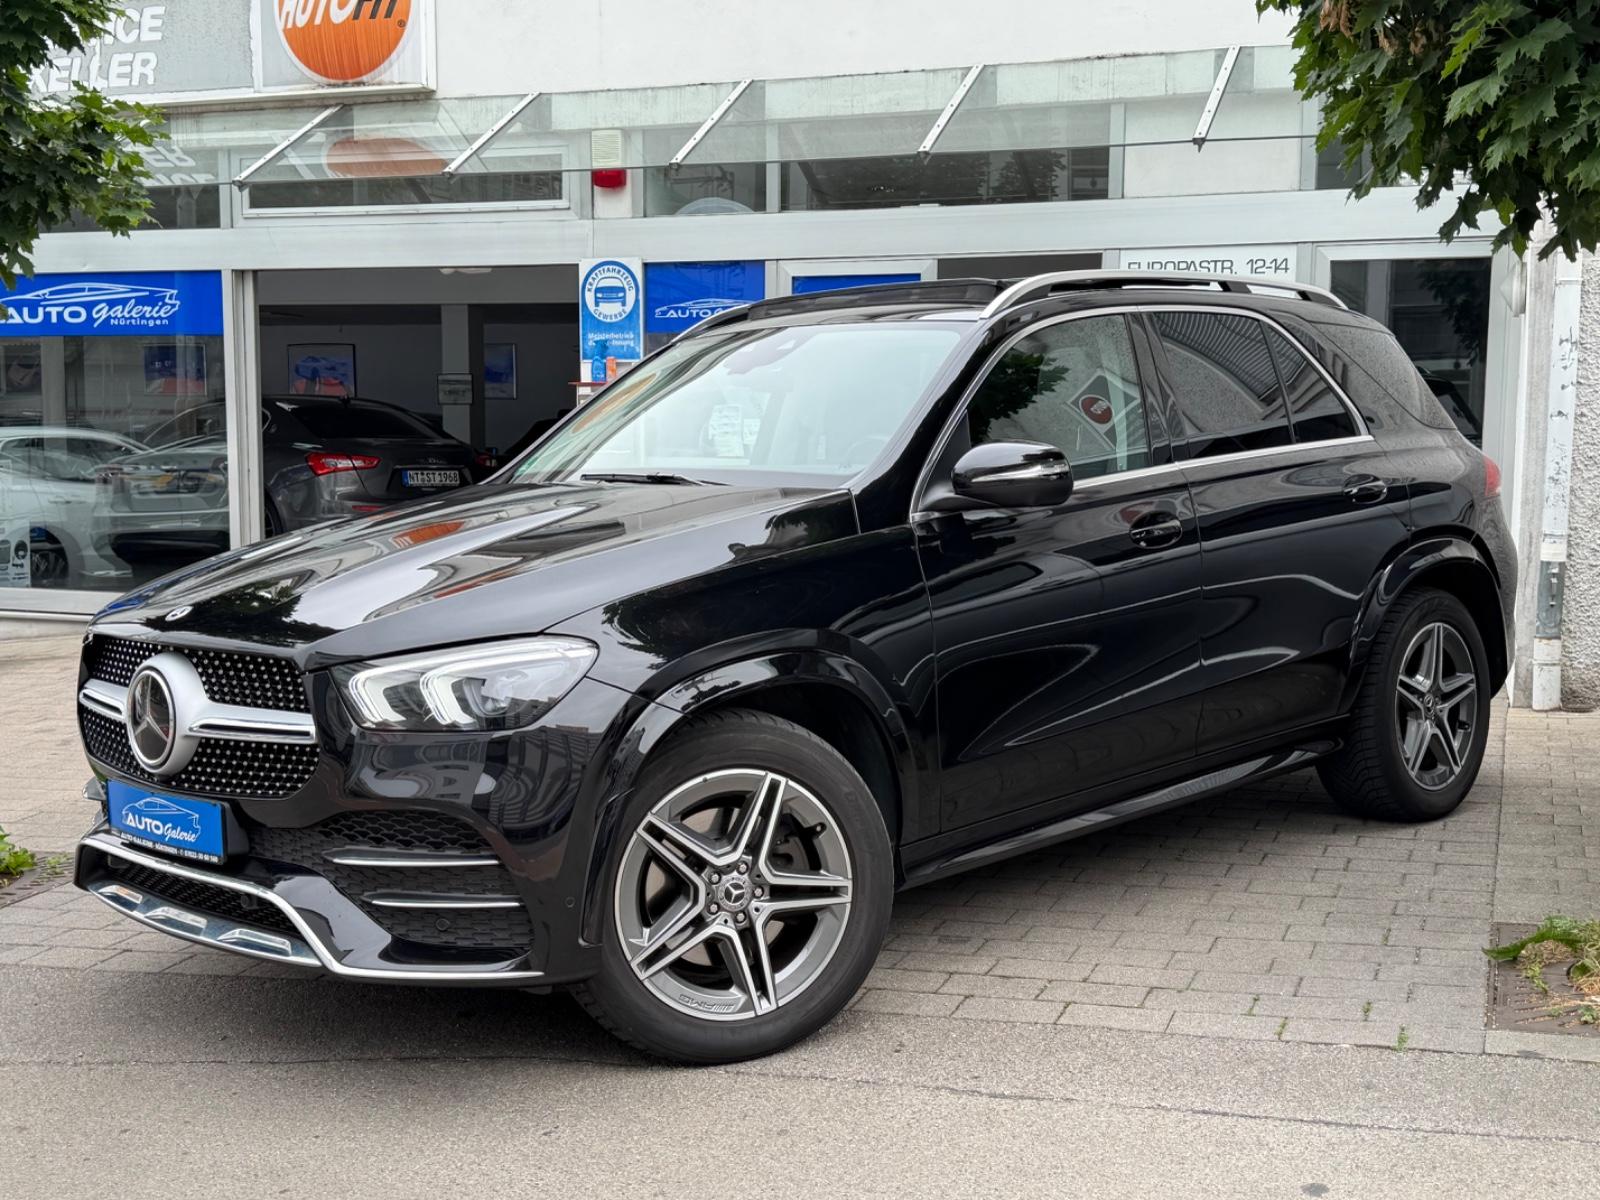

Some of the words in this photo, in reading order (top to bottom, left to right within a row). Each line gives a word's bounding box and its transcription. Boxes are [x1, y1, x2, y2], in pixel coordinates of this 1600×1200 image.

[1246, 258, 1290, 274] 12-14
[587, 266, 634, 292] KRAFTFAHRZEUG
[7, 306, 87, 324] AUTO
[593, 309, 627, 320] GEWERBE
[667, 308, 712, 318] AUTO
[110, 318, 169, 327] Nürtingen
[408, 472, 420, 482] NT
[426, 472, 436, 482] ST
[126, 812, 163, 836] AUTO
